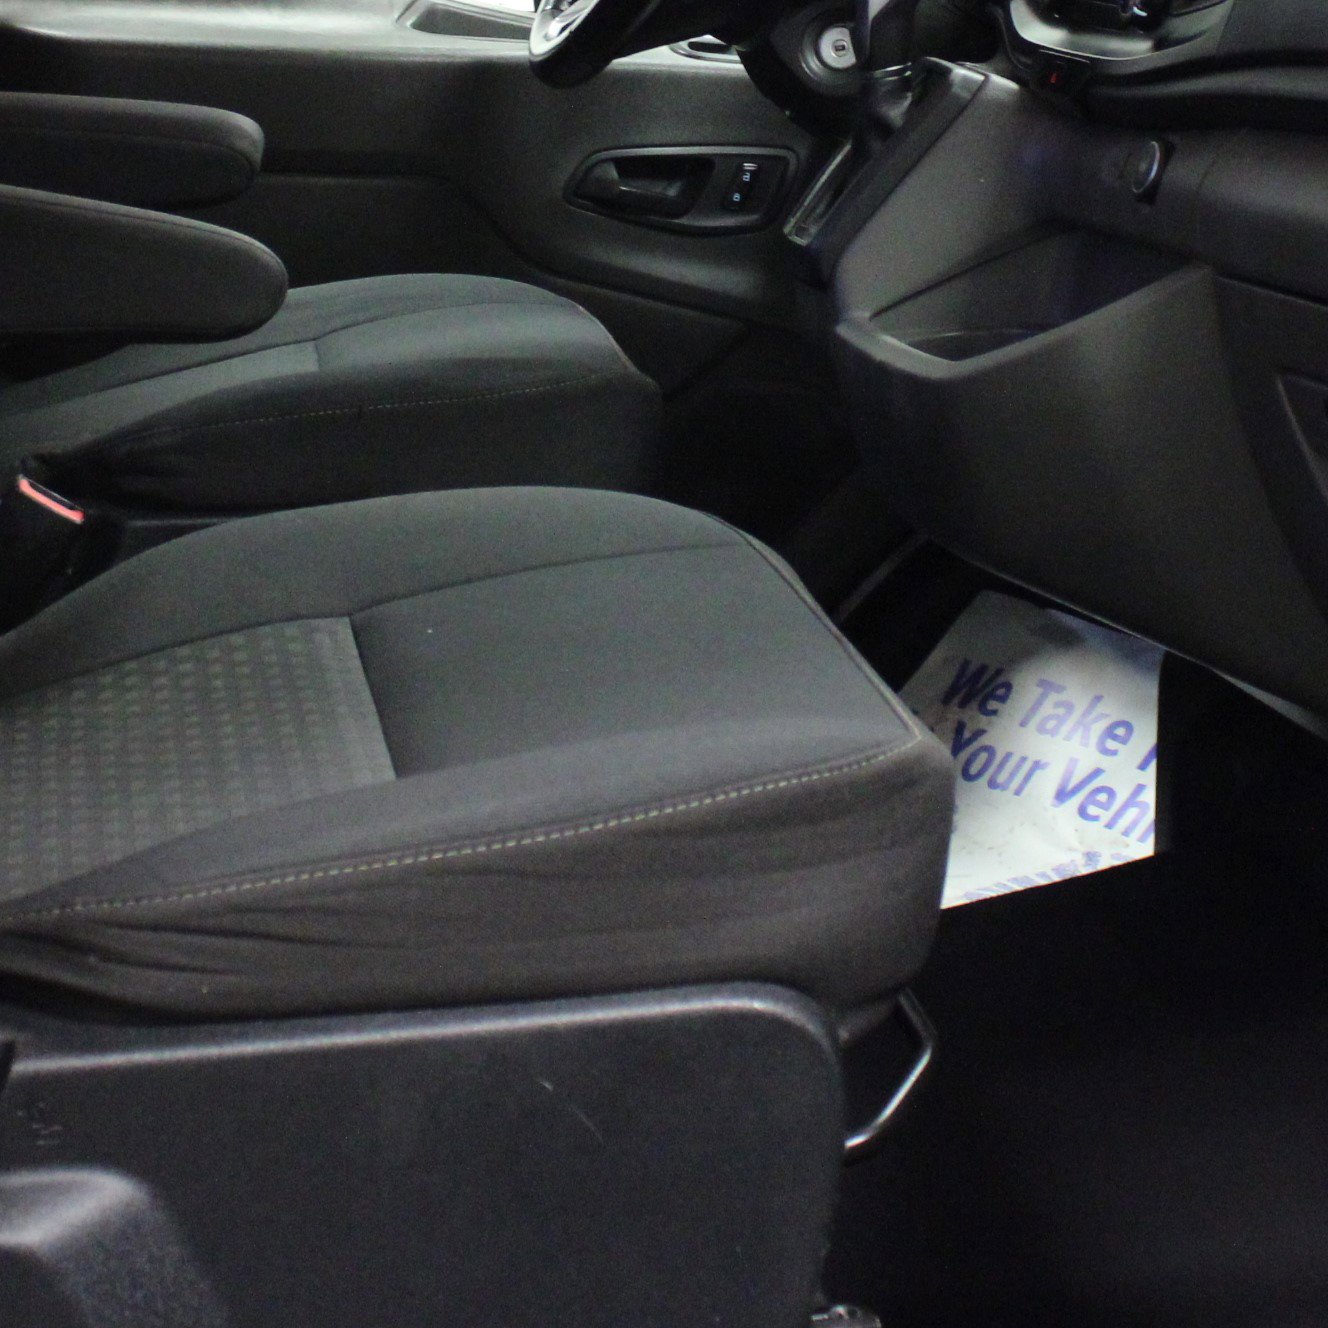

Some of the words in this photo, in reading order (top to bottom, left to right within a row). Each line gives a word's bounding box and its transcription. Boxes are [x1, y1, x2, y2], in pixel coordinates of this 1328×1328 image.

[940, 658, 1014, 717] We
[1019, 678, 1134, 757] Take
[950, 720, 1050, 797] Your
